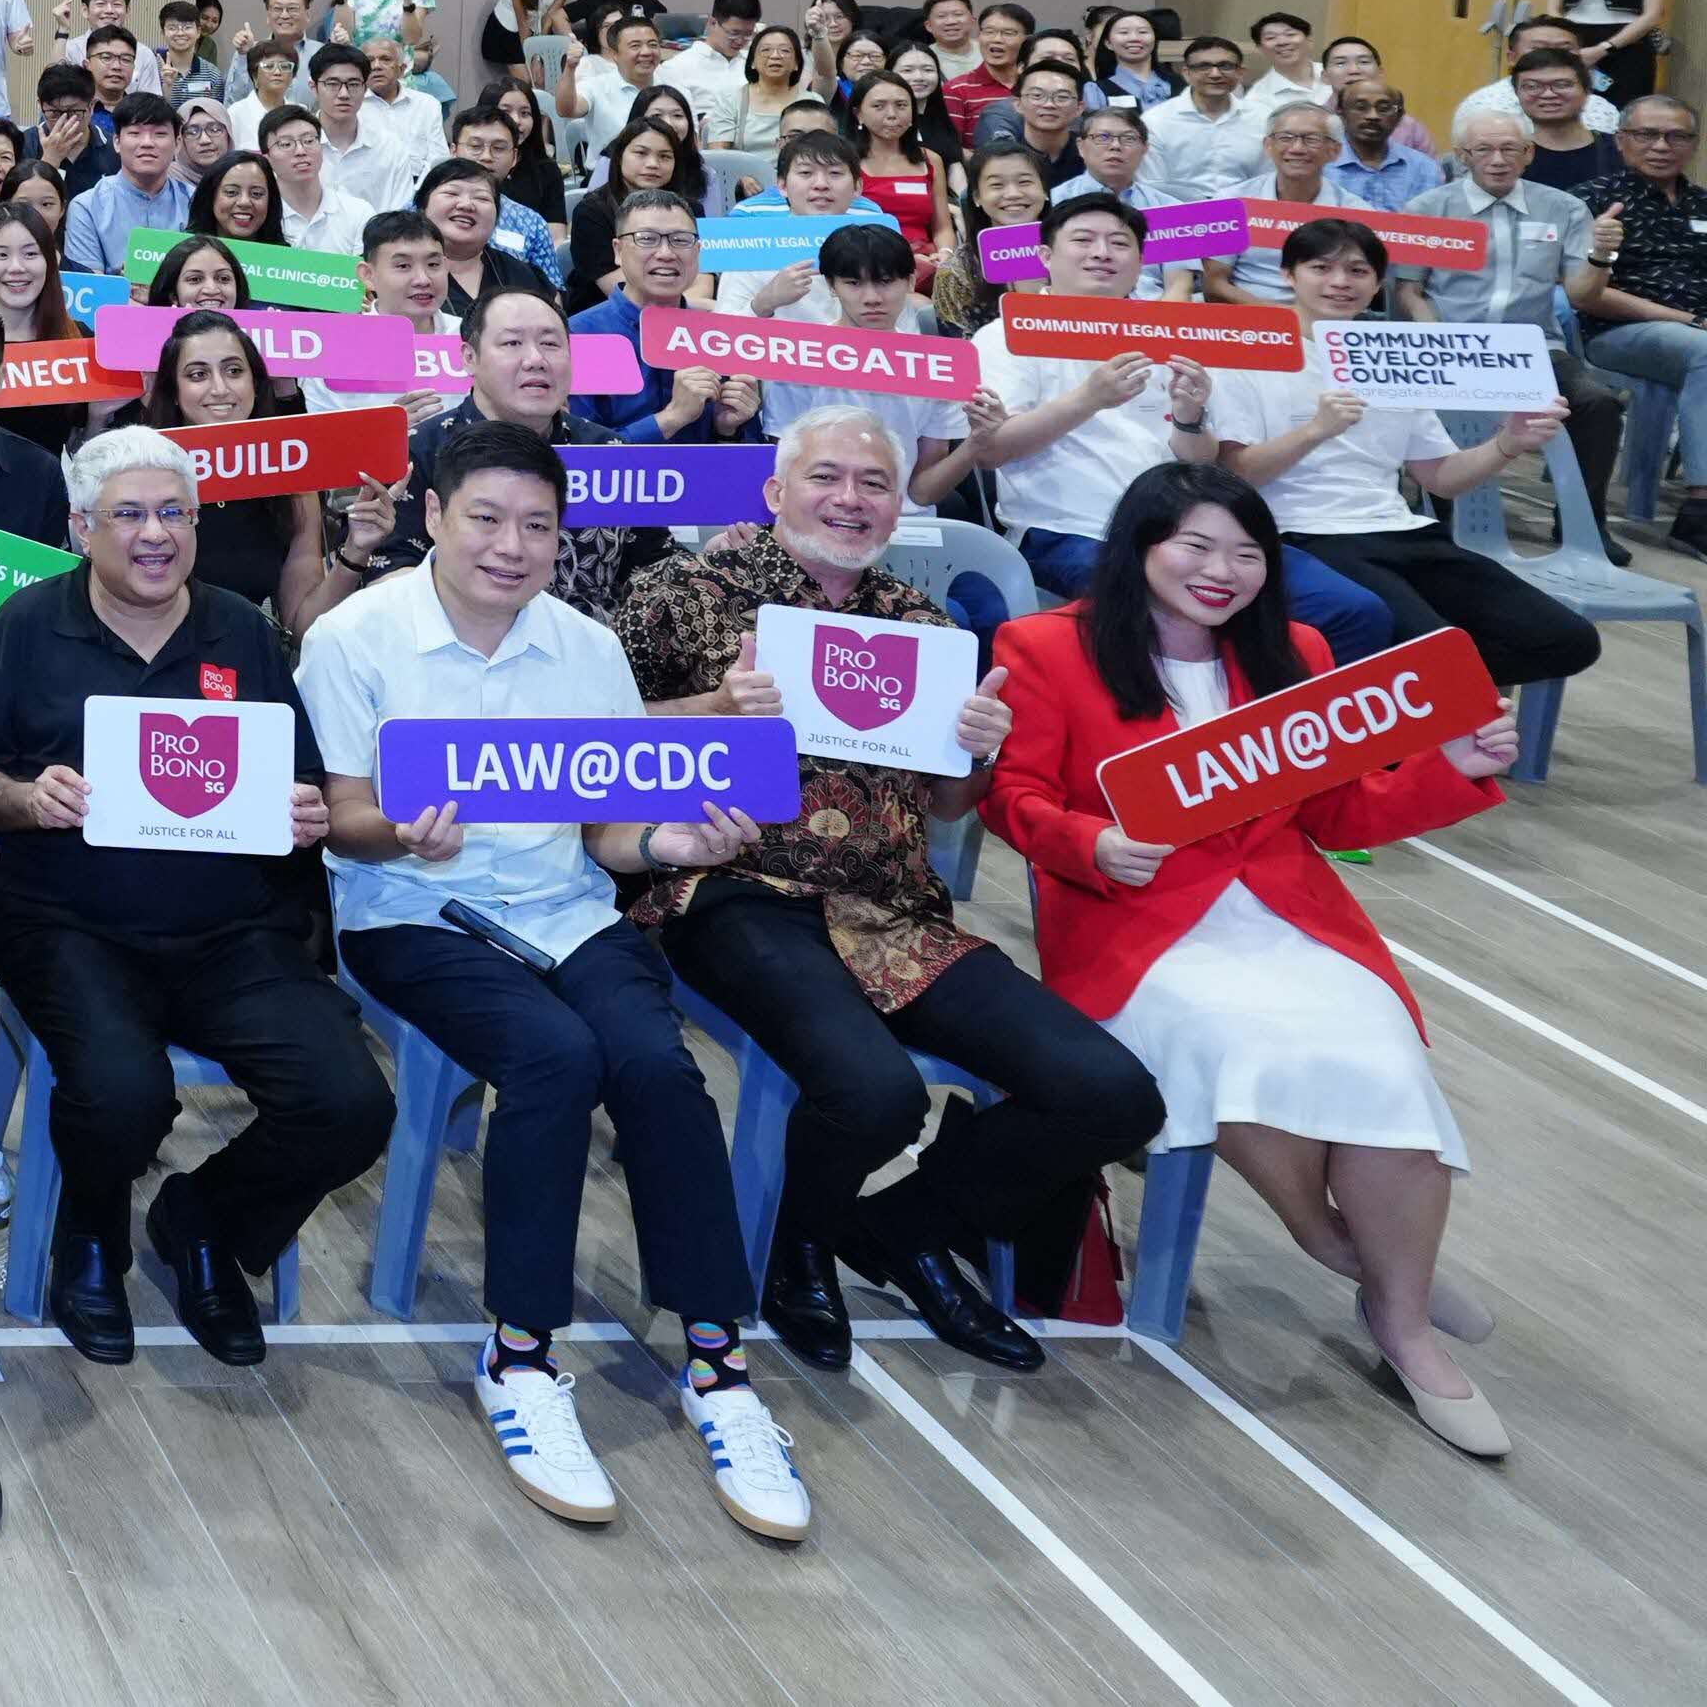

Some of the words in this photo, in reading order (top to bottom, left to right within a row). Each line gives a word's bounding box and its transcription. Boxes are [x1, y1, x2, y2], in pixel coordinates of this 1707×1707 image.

[1145, 219, 1240, 242] LINICS@CDC
[1247, 218, 1274, 229] AW
[775, 236, 814, 248] LEGAL
[267, 266, 360, 291] CLINICS@CDC
[1011, 316, 1118, 337] COMMUNITY
[1122, 323, 1174, 340] LEGAL
[1176, 326, 1294, 346] CLINICS@CDC
[1325, 331, 1492, 349] COMMUNITY
[666, 326, 954, 383] AGGREGATE
[1329, 349, 1534, 368] DEVELOPMENT
[1333, 367, 1456, 385] COUNCIL
[187, 439, 308, 481] BUILD
[566, 469, 685, 504] BUILD
[825, 643, 876, 669] PRO
[202, 679, 232, 694] BONO
[203, 669, 223, 683] PRO
[823, 665, 903, 696] BONO
[879, 697, 901, 711] SG
[151, 731, 200, 755] PRO
[807, 733, 858, 749] JUSTICE
[862, 741, 887, 754] FOR
[890, 745, 912, 757] ALL
[1164, 670, 1434, 809] LAW@CDC
[150, 754, 226, 779] BONO
[445, 741, 732, 800] LAW@CDC
[204, 782, 225, 794] SG
[138, 825, 186, 837] JUSTICE
[190, 828, 213, 839] FOR
[216, 830, 237, 840] ALL
